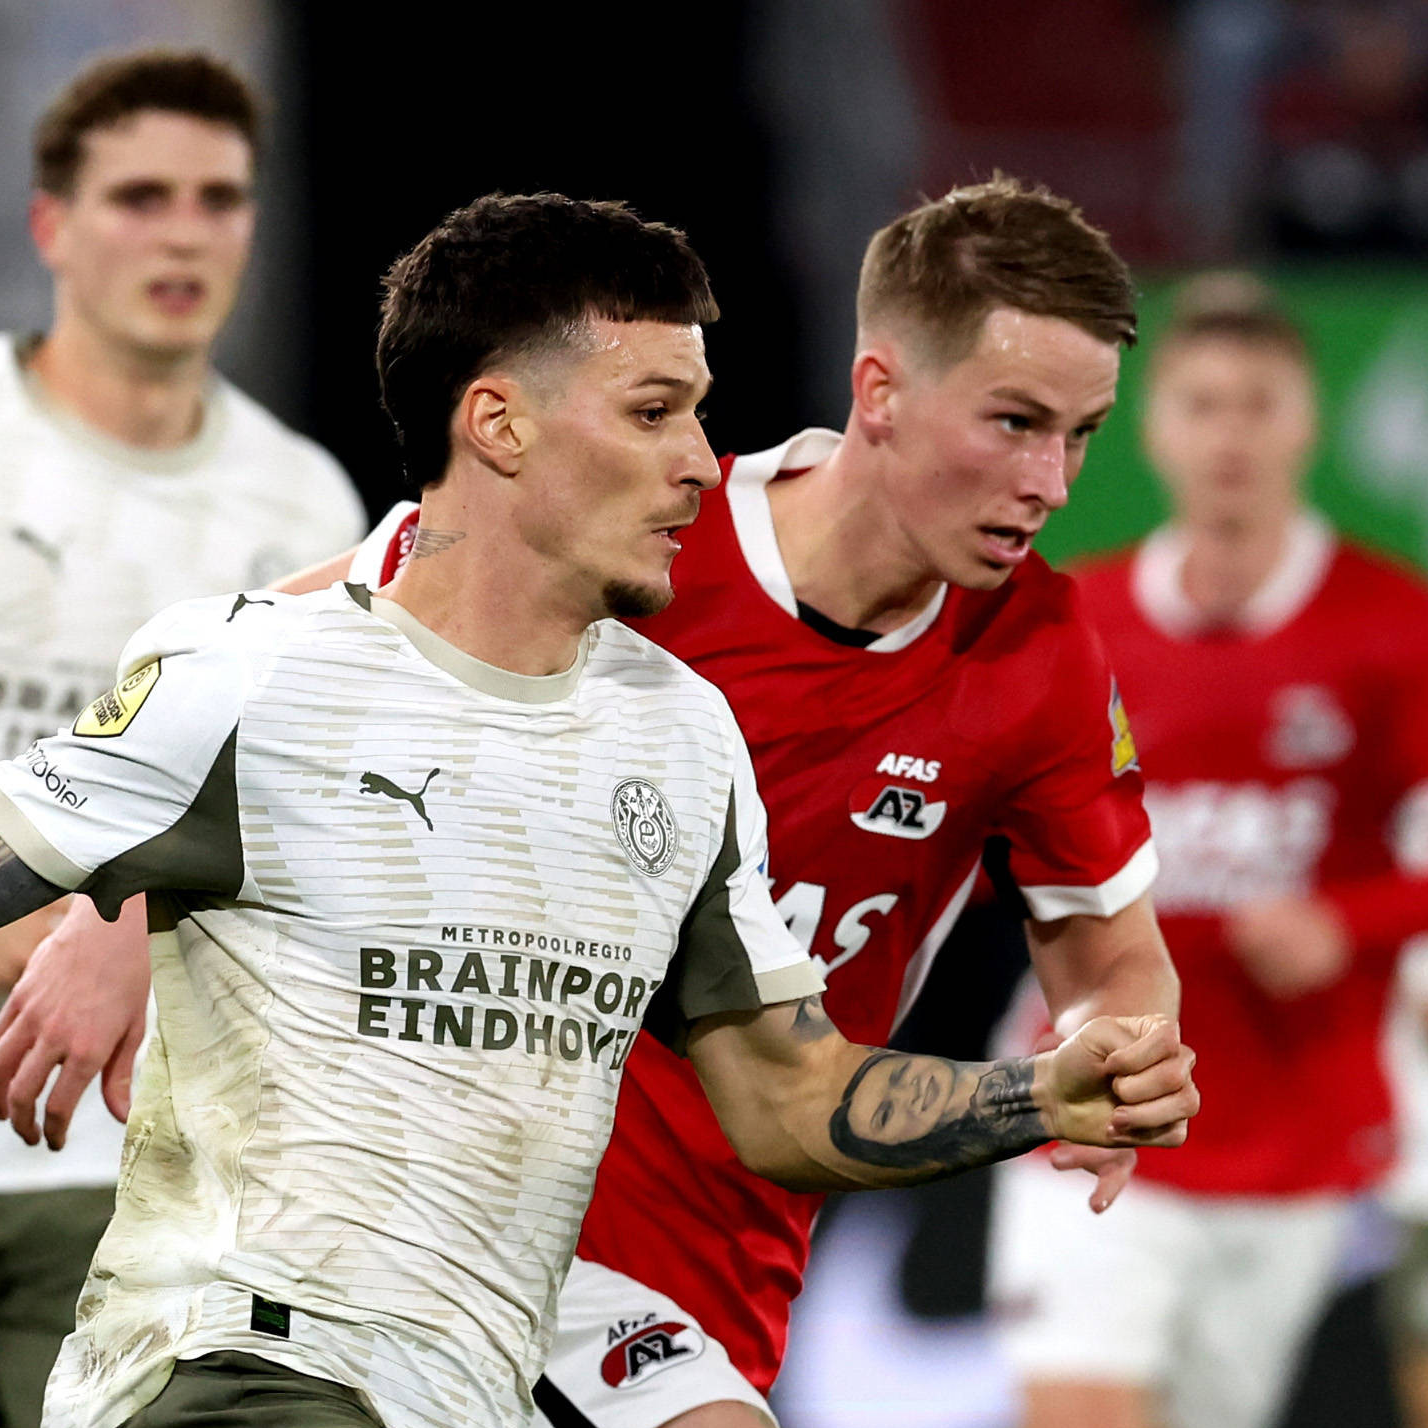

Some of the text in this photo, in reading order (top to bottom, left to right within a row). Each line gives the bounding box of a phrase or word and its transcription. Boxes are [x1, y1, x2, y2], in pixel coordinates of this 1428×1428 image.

[26, 741, 88, 809] mobiel
[876, 752, 942, 783] AFAS
[867, 787, 926, 828] AZ
[440, 926, 633, 963] METROPOOLREGIO
[775, 880, 900, 980] AS
[359, 946, 663, 1019] BRAINPOR
[356, 993, 636, 1071] EINDHOVE
[628, 1331, 693, 1379] AZ
